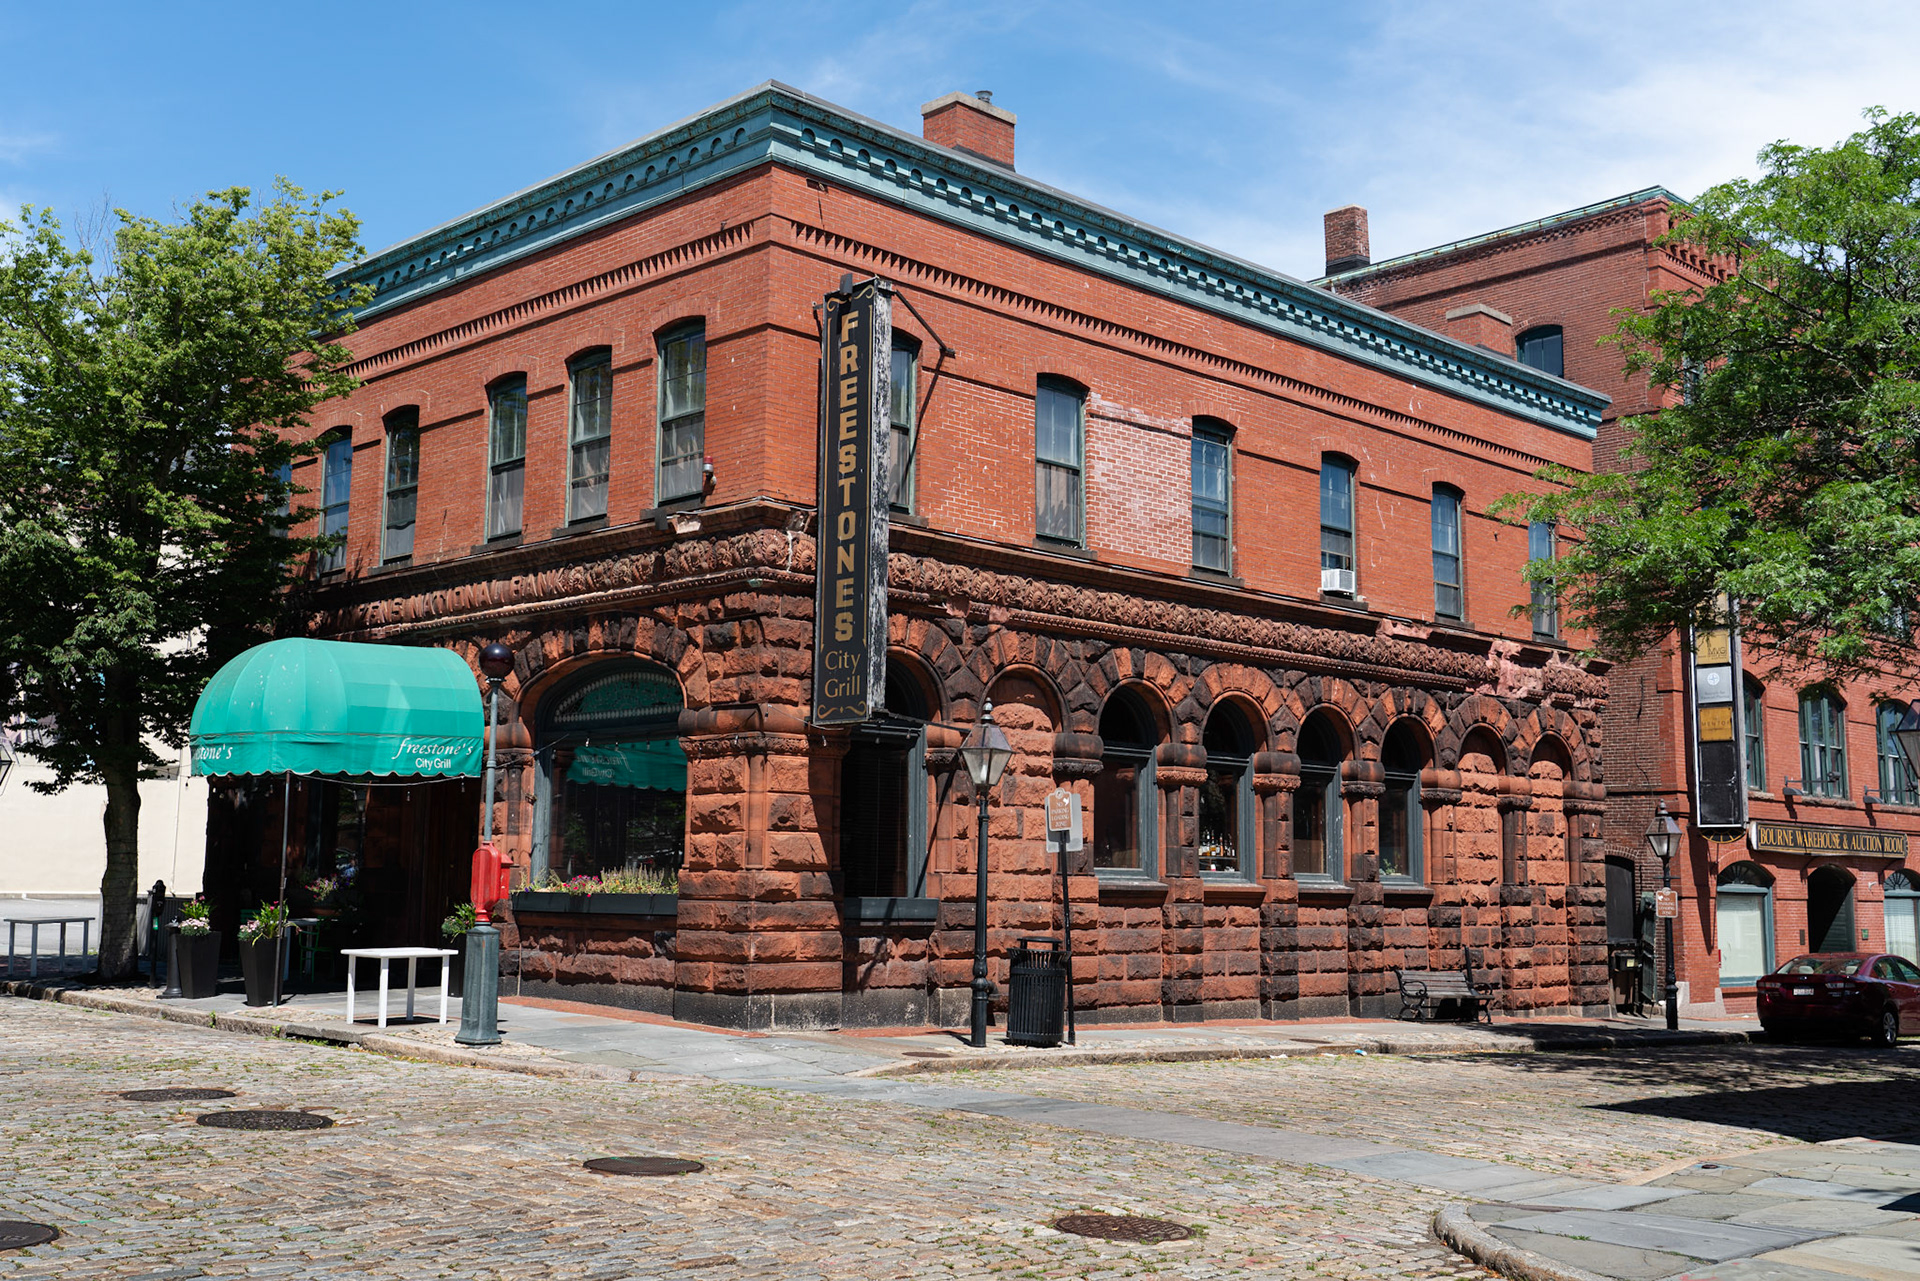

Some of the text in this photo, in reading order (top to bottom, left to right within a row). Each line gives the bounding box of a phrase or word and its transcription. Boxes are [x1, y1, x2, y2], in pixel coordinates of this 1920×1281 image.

[834, 312, 860, 642] FREESTONES
[825, 649, 861, 674] City
[824, 674, 860, 698] Grill
[391, 737, 473, 760] freestone's
[415, 757, 451, 771] City Grill
[1760, 827, 1794, 847] BOURNE
[1795, 829, 1841, 849] WAREHOUSE
[1843, 835, 1849, 850] &
[1850, 834, 1882, 852] AUCTION
